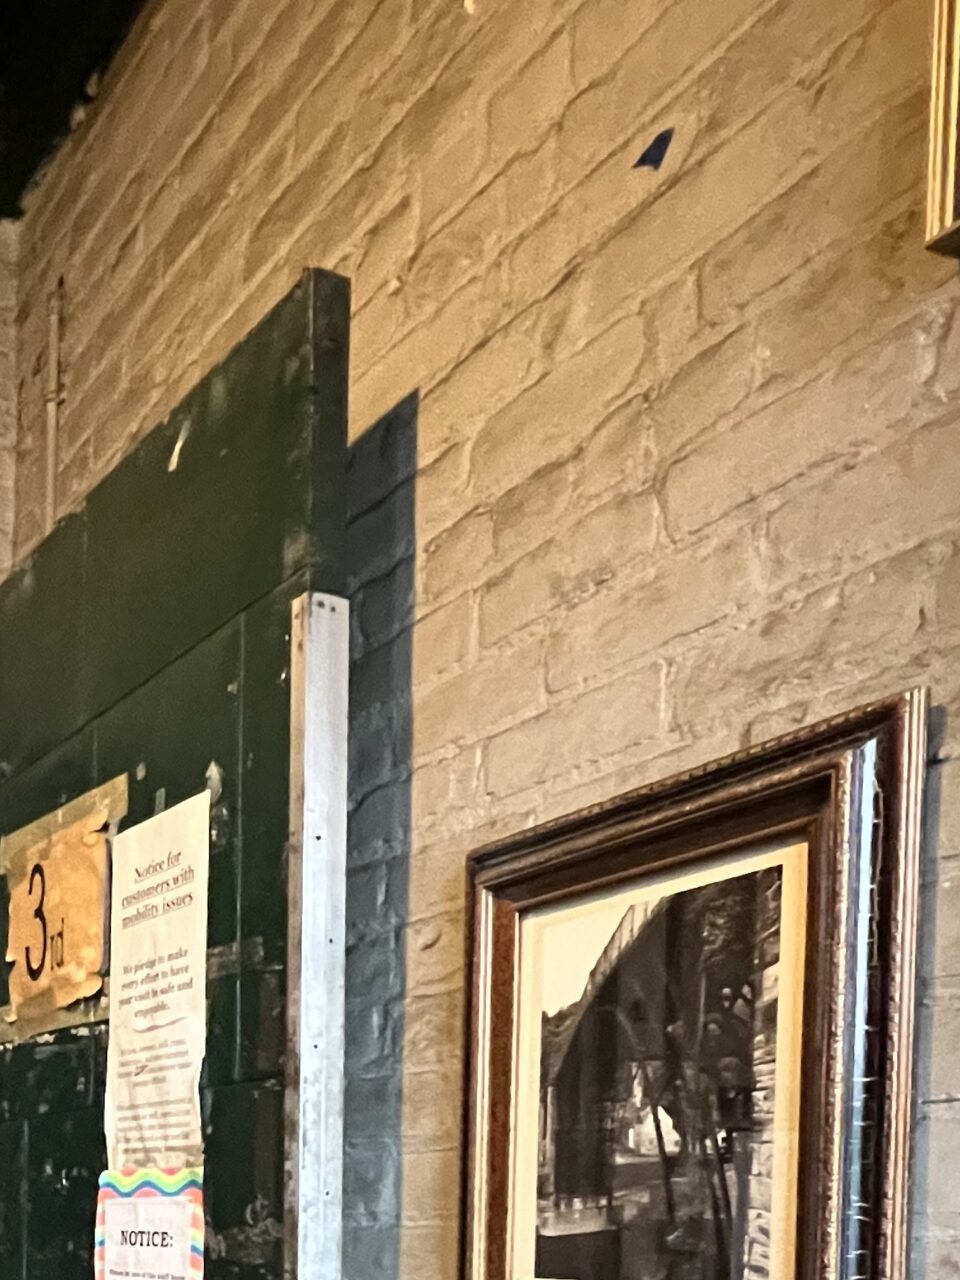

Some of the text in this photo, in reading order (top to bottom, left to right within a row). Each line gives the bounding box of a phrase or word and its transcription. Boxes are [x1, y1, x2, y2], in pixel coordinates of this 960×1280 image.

[134, 851, 182, 879] Notice for
[122, 865, 195, 907] customers with
[24, 864, 65, 982] 3rd
[122, 892, 194, 929] mobility issues
[177, 977, 193, 991] and
[120, 1230, 173, 1248] NOTICE:
